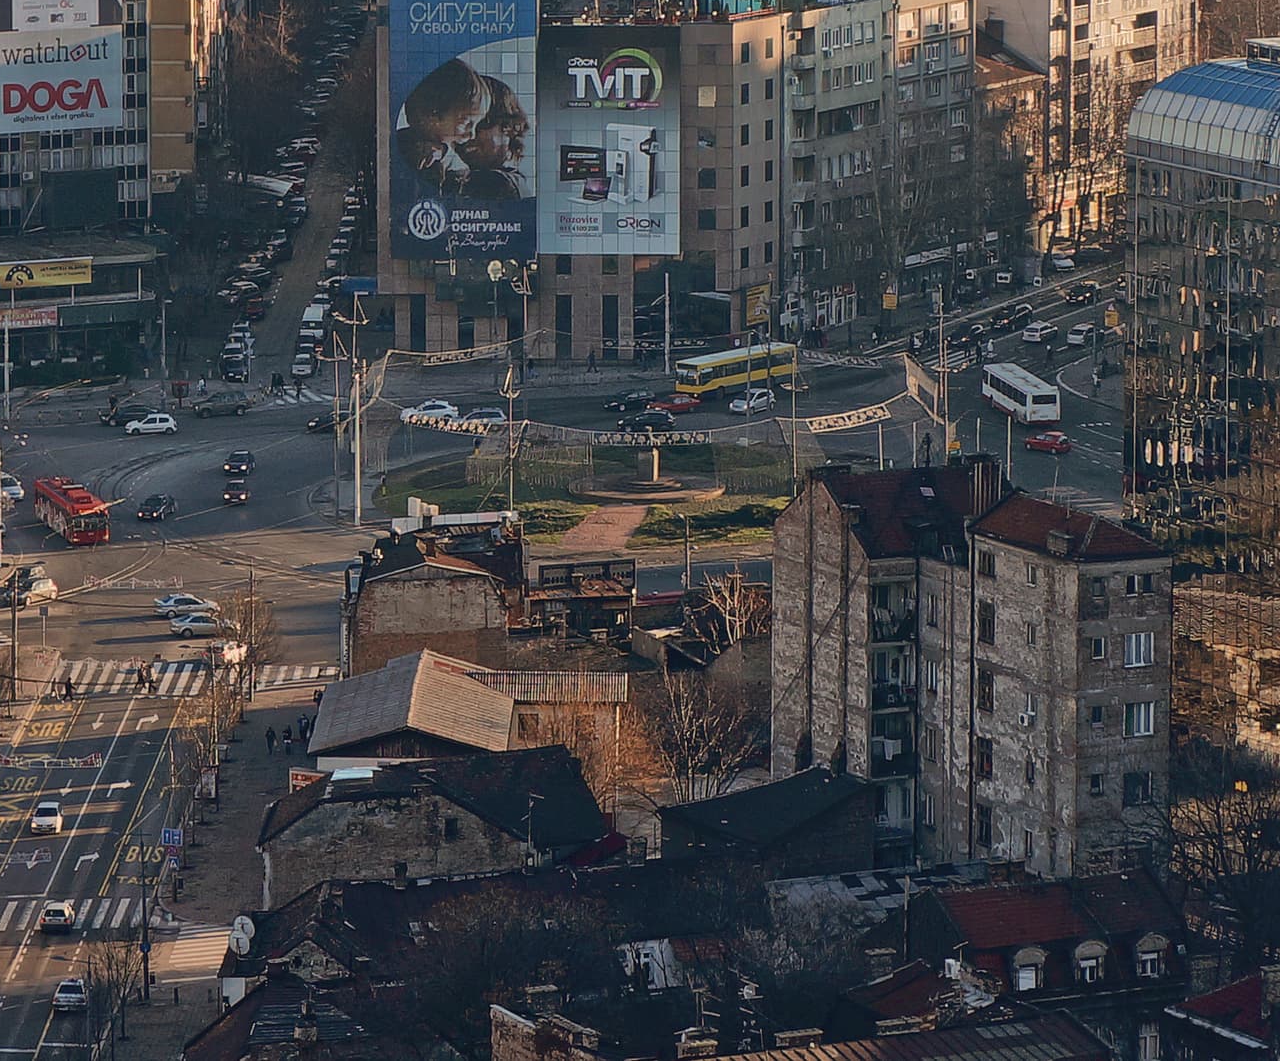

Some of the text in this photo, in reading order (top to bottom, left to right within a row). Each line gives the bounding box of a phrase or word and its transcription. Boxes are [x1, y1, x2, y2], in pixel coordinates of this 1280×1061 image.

[409, 2, 515, 22] СИГУРНИ
[422, 22, 467, 35] СВОЈУ
[471, 22, 515, 34] СНАГУ
[2, 78, 109, 115] DOGA
[451, 210, 490, 221] ДУНАВ
[616, 217, 661, 229] ORION
[452, 222, 521, 233] ОСИГУРАЊЕ
[28, 722, 66, 737] BUS
[0, 776, 39, 791] BUS
[125, 845, 165, 863] BUS
